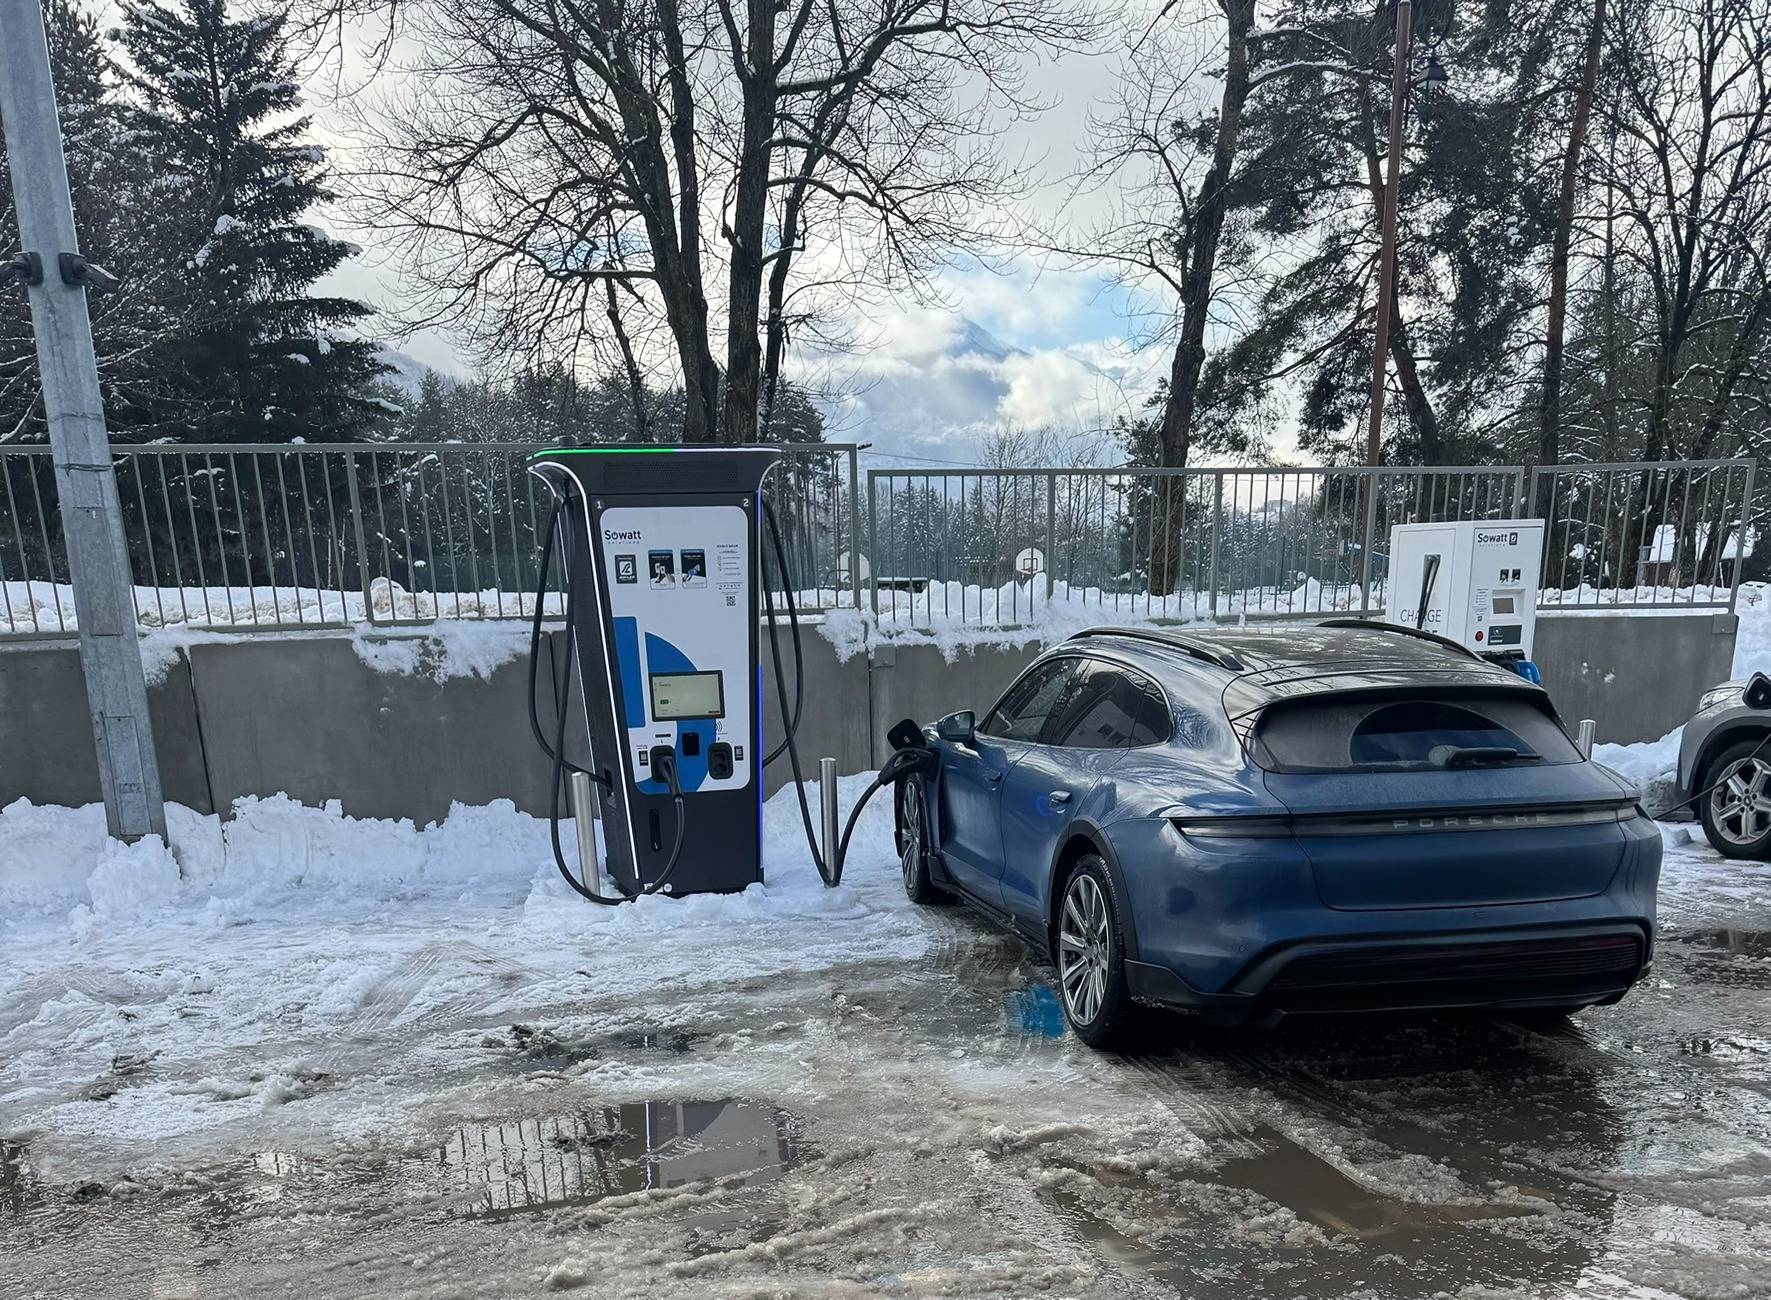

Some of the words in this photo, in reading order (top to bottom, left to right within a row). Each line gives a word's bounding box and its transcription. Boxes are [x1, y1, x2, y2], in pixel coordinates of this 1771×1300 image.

[596, 500, 602, 509] 1
[743, 498, 750, 507] 2
[604, 529, 642, 540] Sowatt
[1477, 533, 1507, 543] Sowatt
[1400, 609, 1442, 622] CHGE
[1392, 813, 1550, 829] PORSCHE
